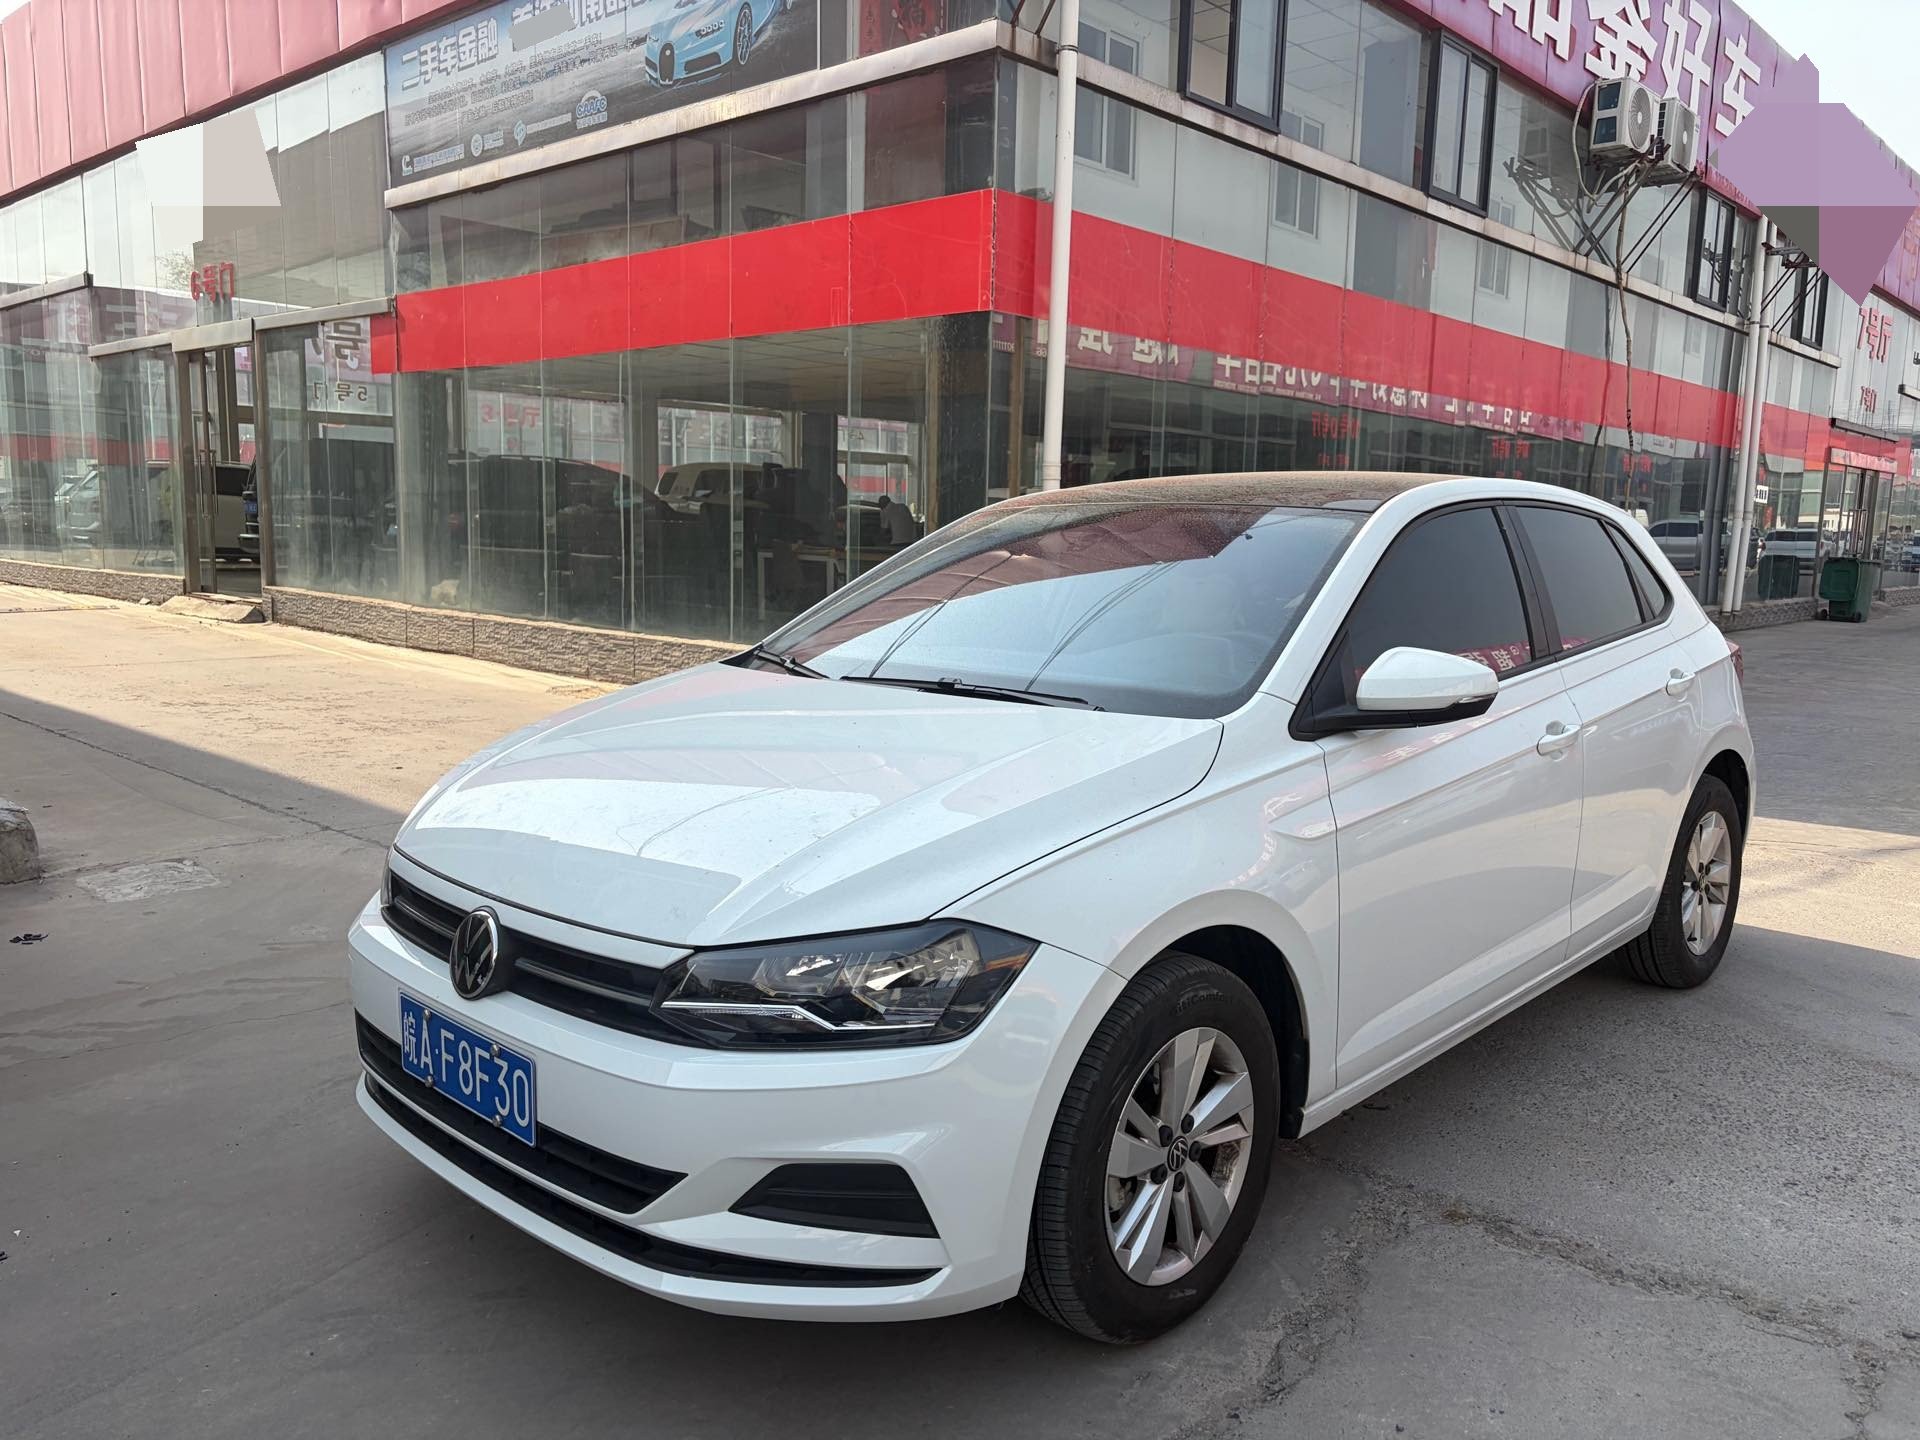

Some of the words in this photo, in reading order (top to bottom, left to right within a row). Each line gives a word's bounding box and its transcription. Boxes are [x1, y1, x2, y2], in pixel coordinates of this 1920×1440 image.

[402, 18, 499, 91] 二手车金融
